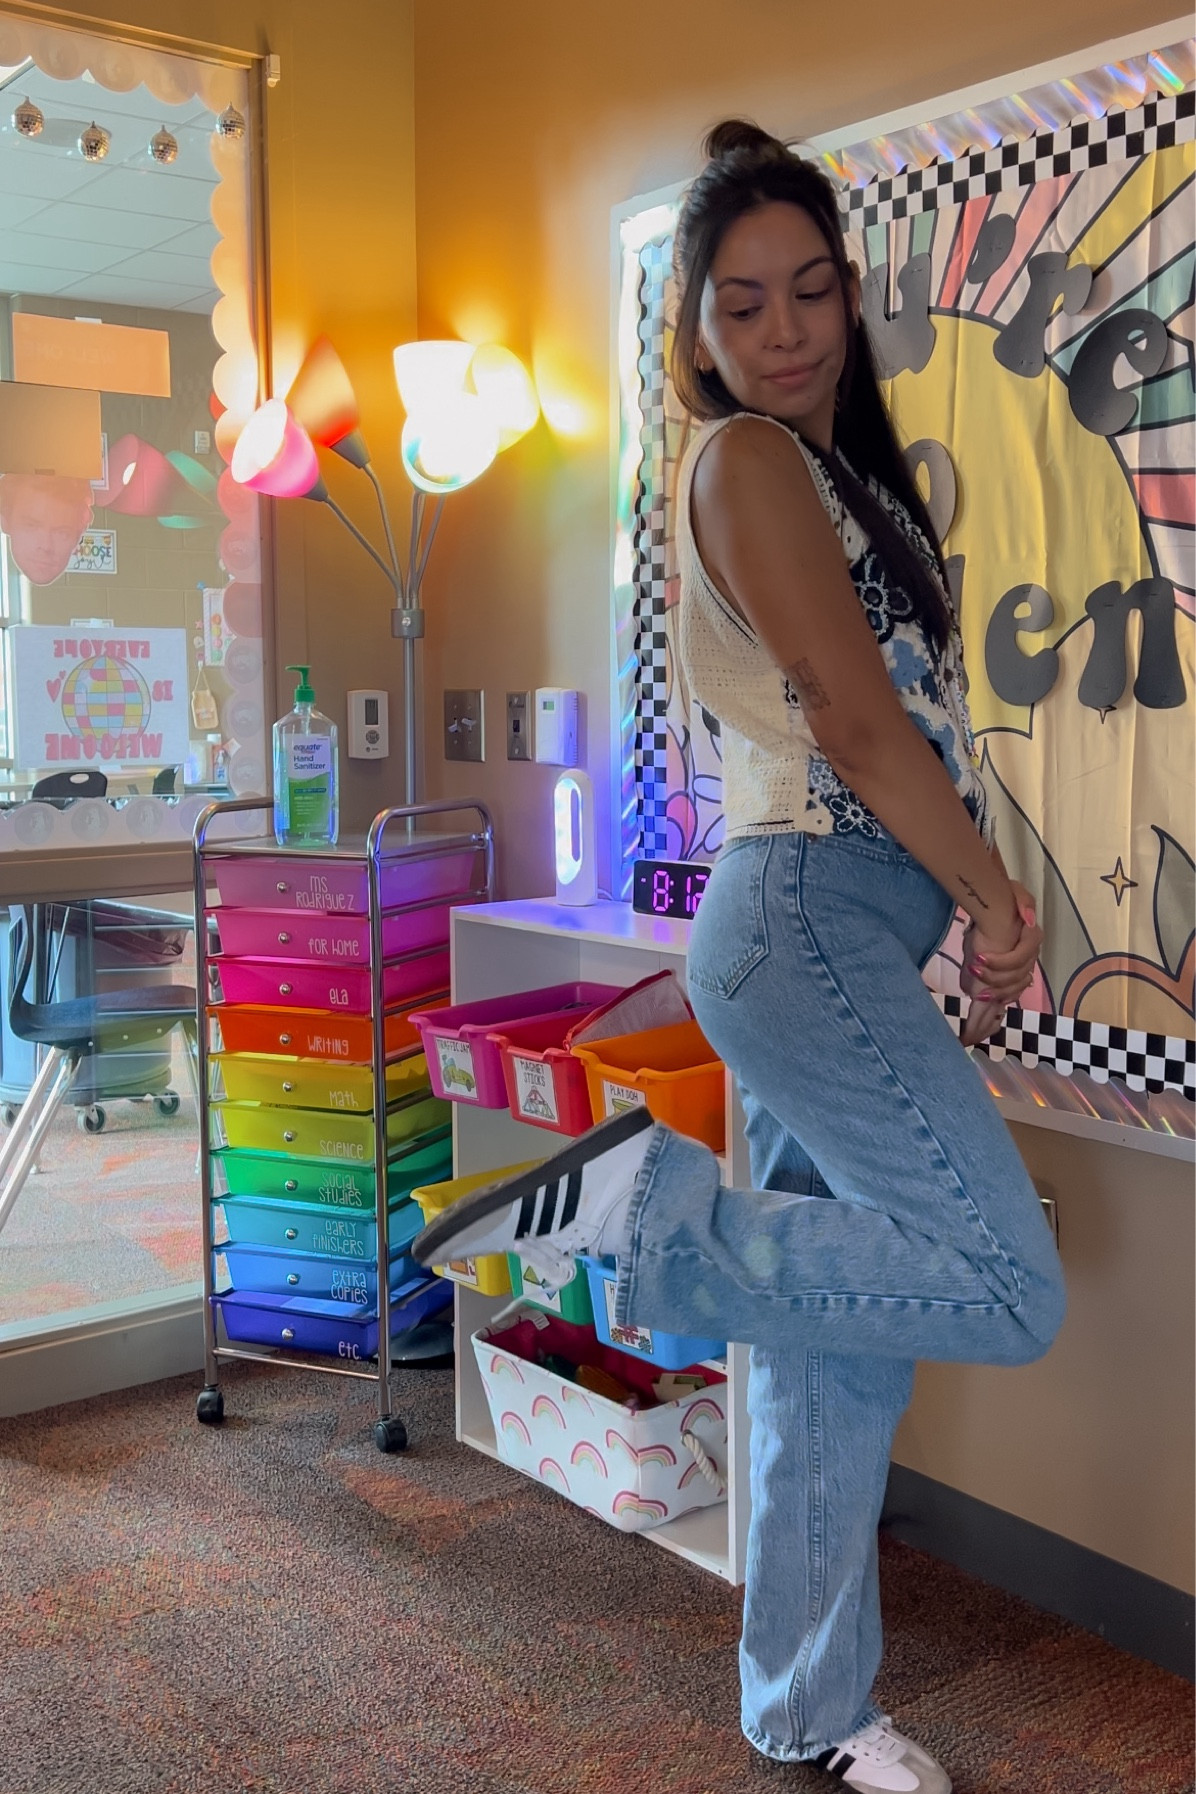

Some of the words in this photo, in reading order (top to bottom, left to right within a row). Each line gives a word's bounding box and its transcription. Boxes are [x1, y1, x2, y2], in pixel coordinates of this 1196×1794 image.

[72, 545, 112, 557] HOOSE
[294, 762, 326, 770] Sanitizer
[610, 1084, 625, 1098] PLAY
